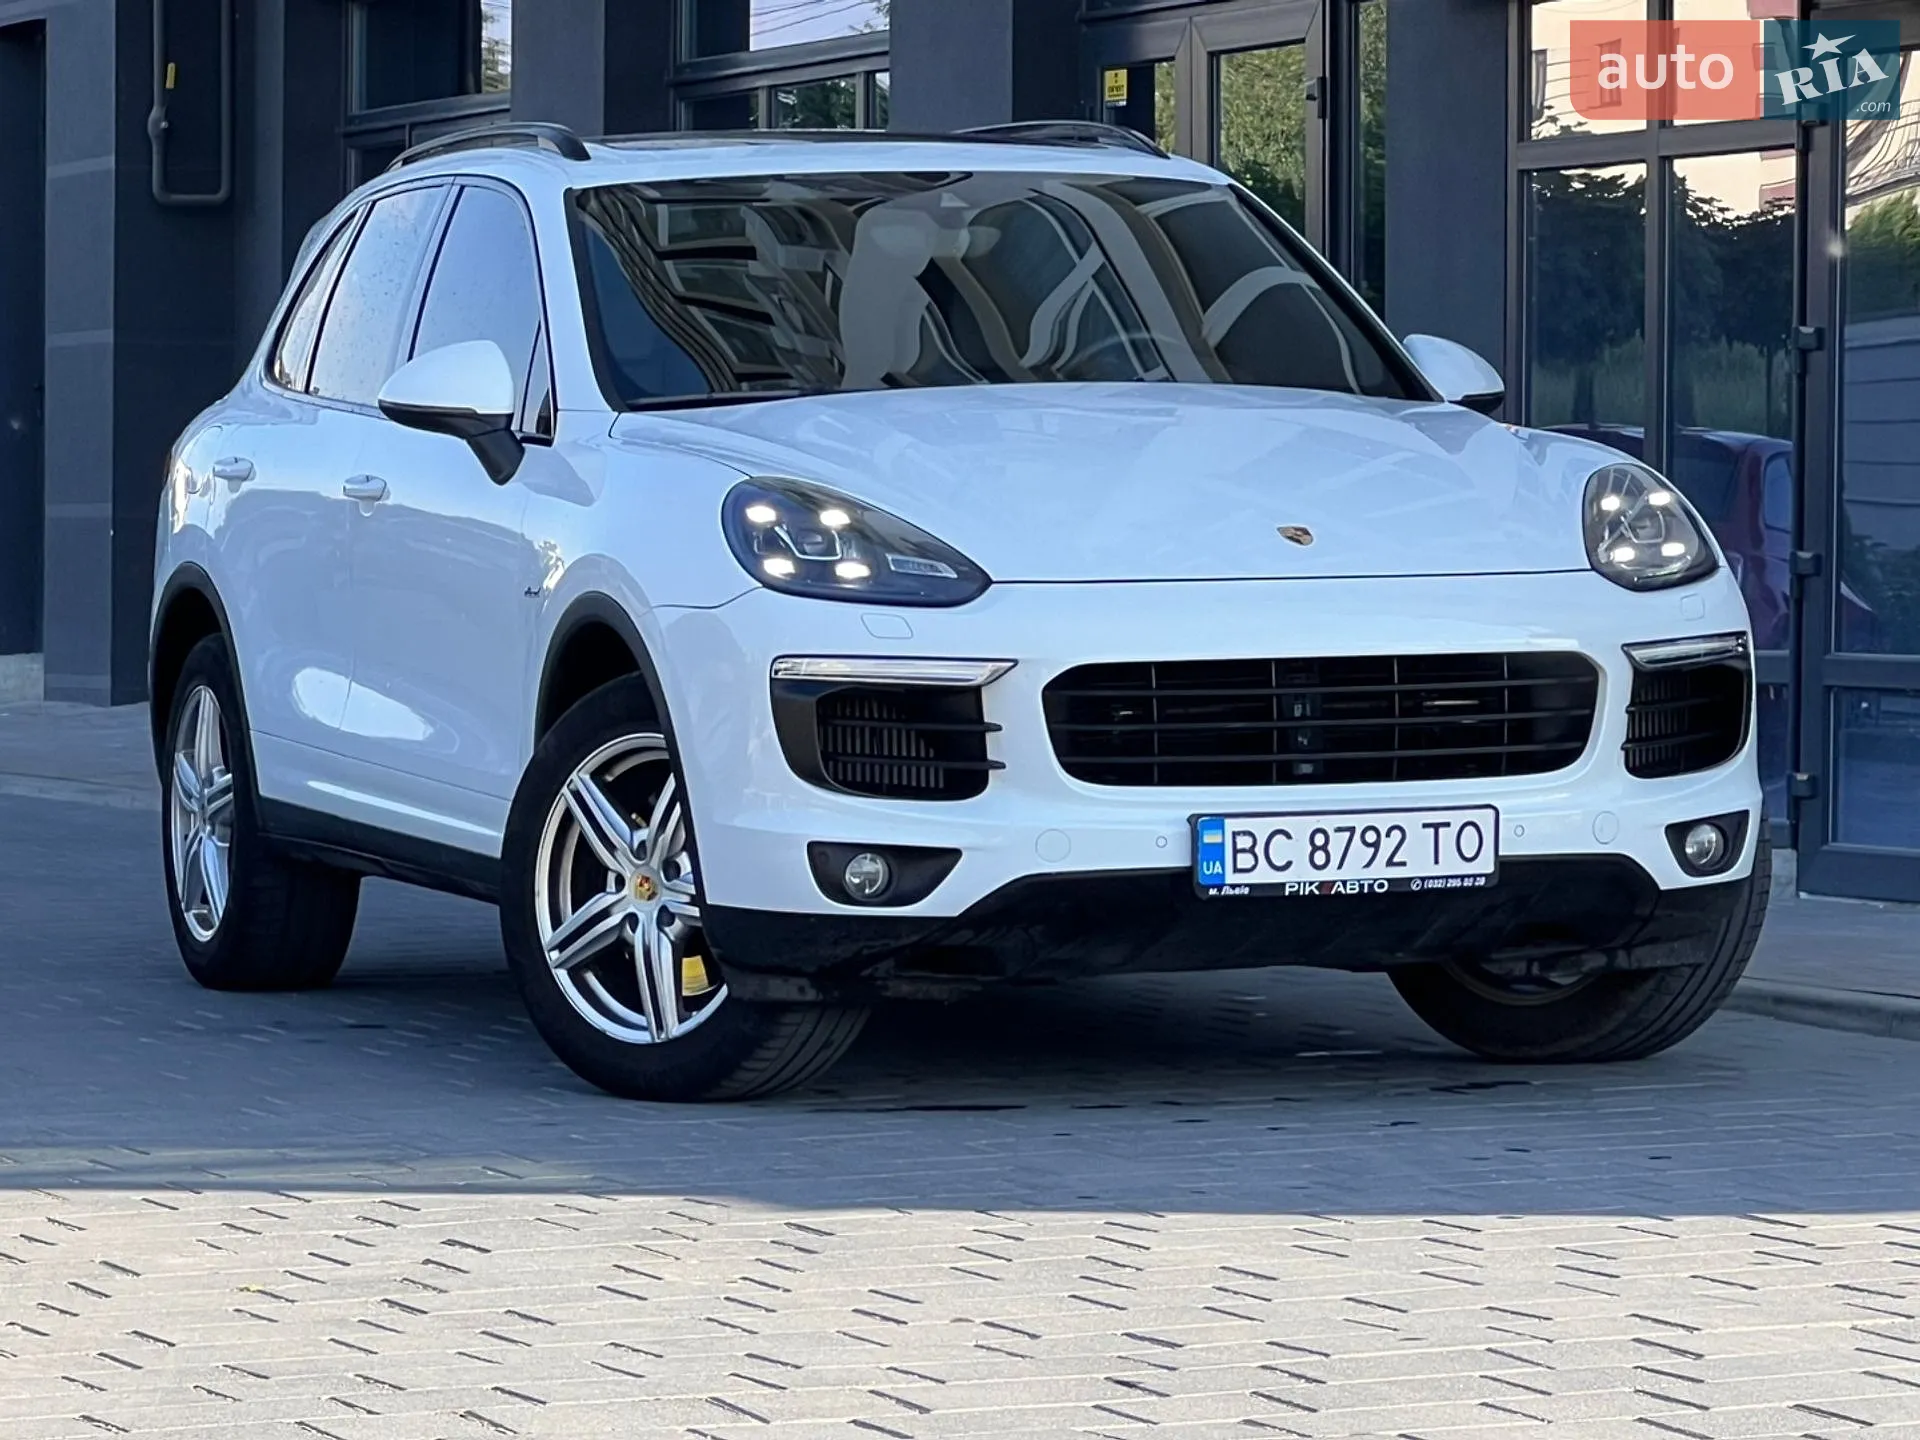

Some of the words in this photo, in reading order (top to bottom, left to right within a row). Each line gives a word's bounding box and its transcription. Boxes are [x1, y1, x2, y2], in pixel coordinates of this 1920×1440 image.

[1231, 828, 1294, 874] BC
[1308, 825, 1408, 871] 8792
[1421, 820, 1484, 865] TO
[1203, 861, 1223, 876] UA
